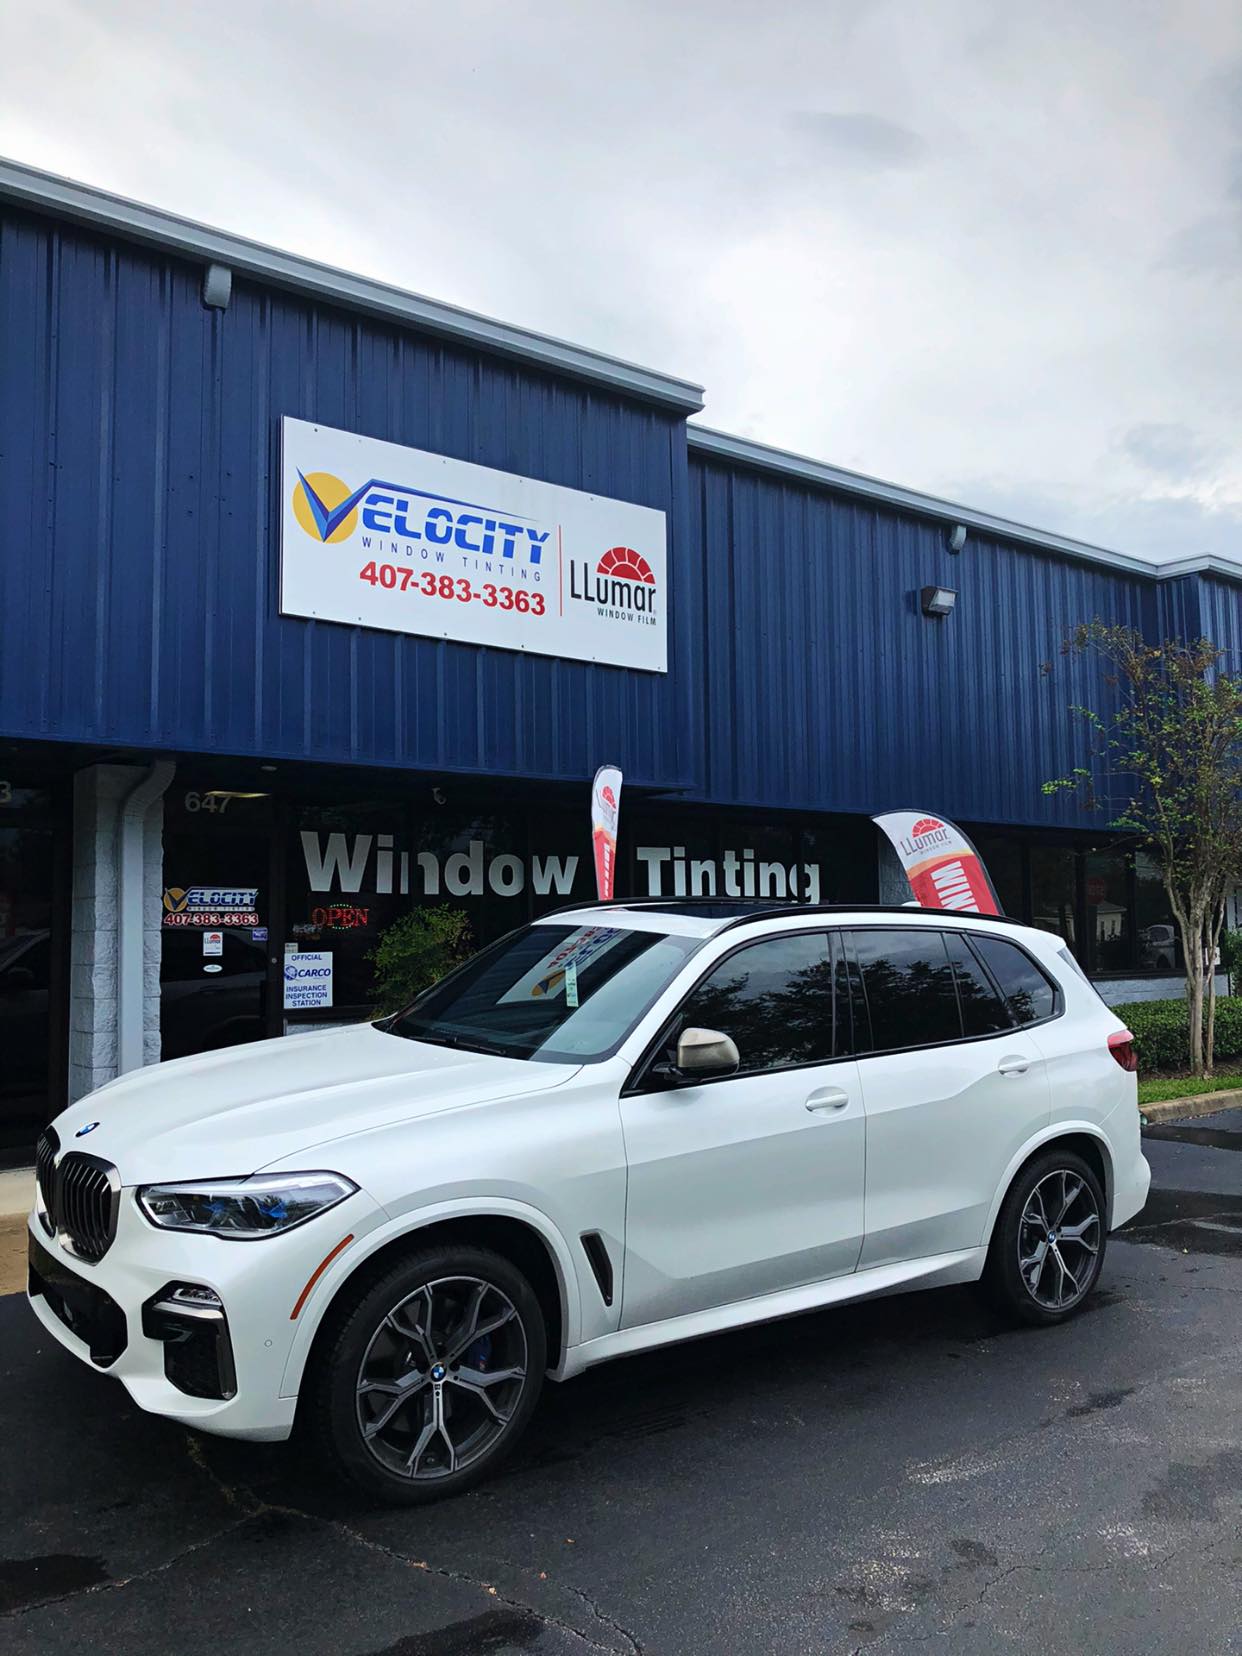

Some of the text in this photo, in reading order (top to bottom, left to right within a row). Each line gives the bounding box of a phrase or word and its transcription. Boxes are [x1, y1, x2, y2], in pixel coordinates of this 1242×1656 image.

[362, 537, 541, 582] WINDOW TINTING
[359, 561, 546, 616] 407-383-3363
[570, 560, 656, 613] LLumar
[597, 608, 657, 625] WINDOW FILM
[184, 791, 232, 814] 647
[900, 828, 948, 856] LLumar
[300, 831, 579, 896] Window
[636, 846, 821, 905] Tinting
[930, 860, 981, 913] WIN
[164, 913, 260, 926] 407-383-3363
[311, 908, 369, 928] OPEN
[298, 968, 331, 977] CARCO
[285, 992, 328, 1000] INSPECTION
[286, 984, 327, 993] INSURANCE
